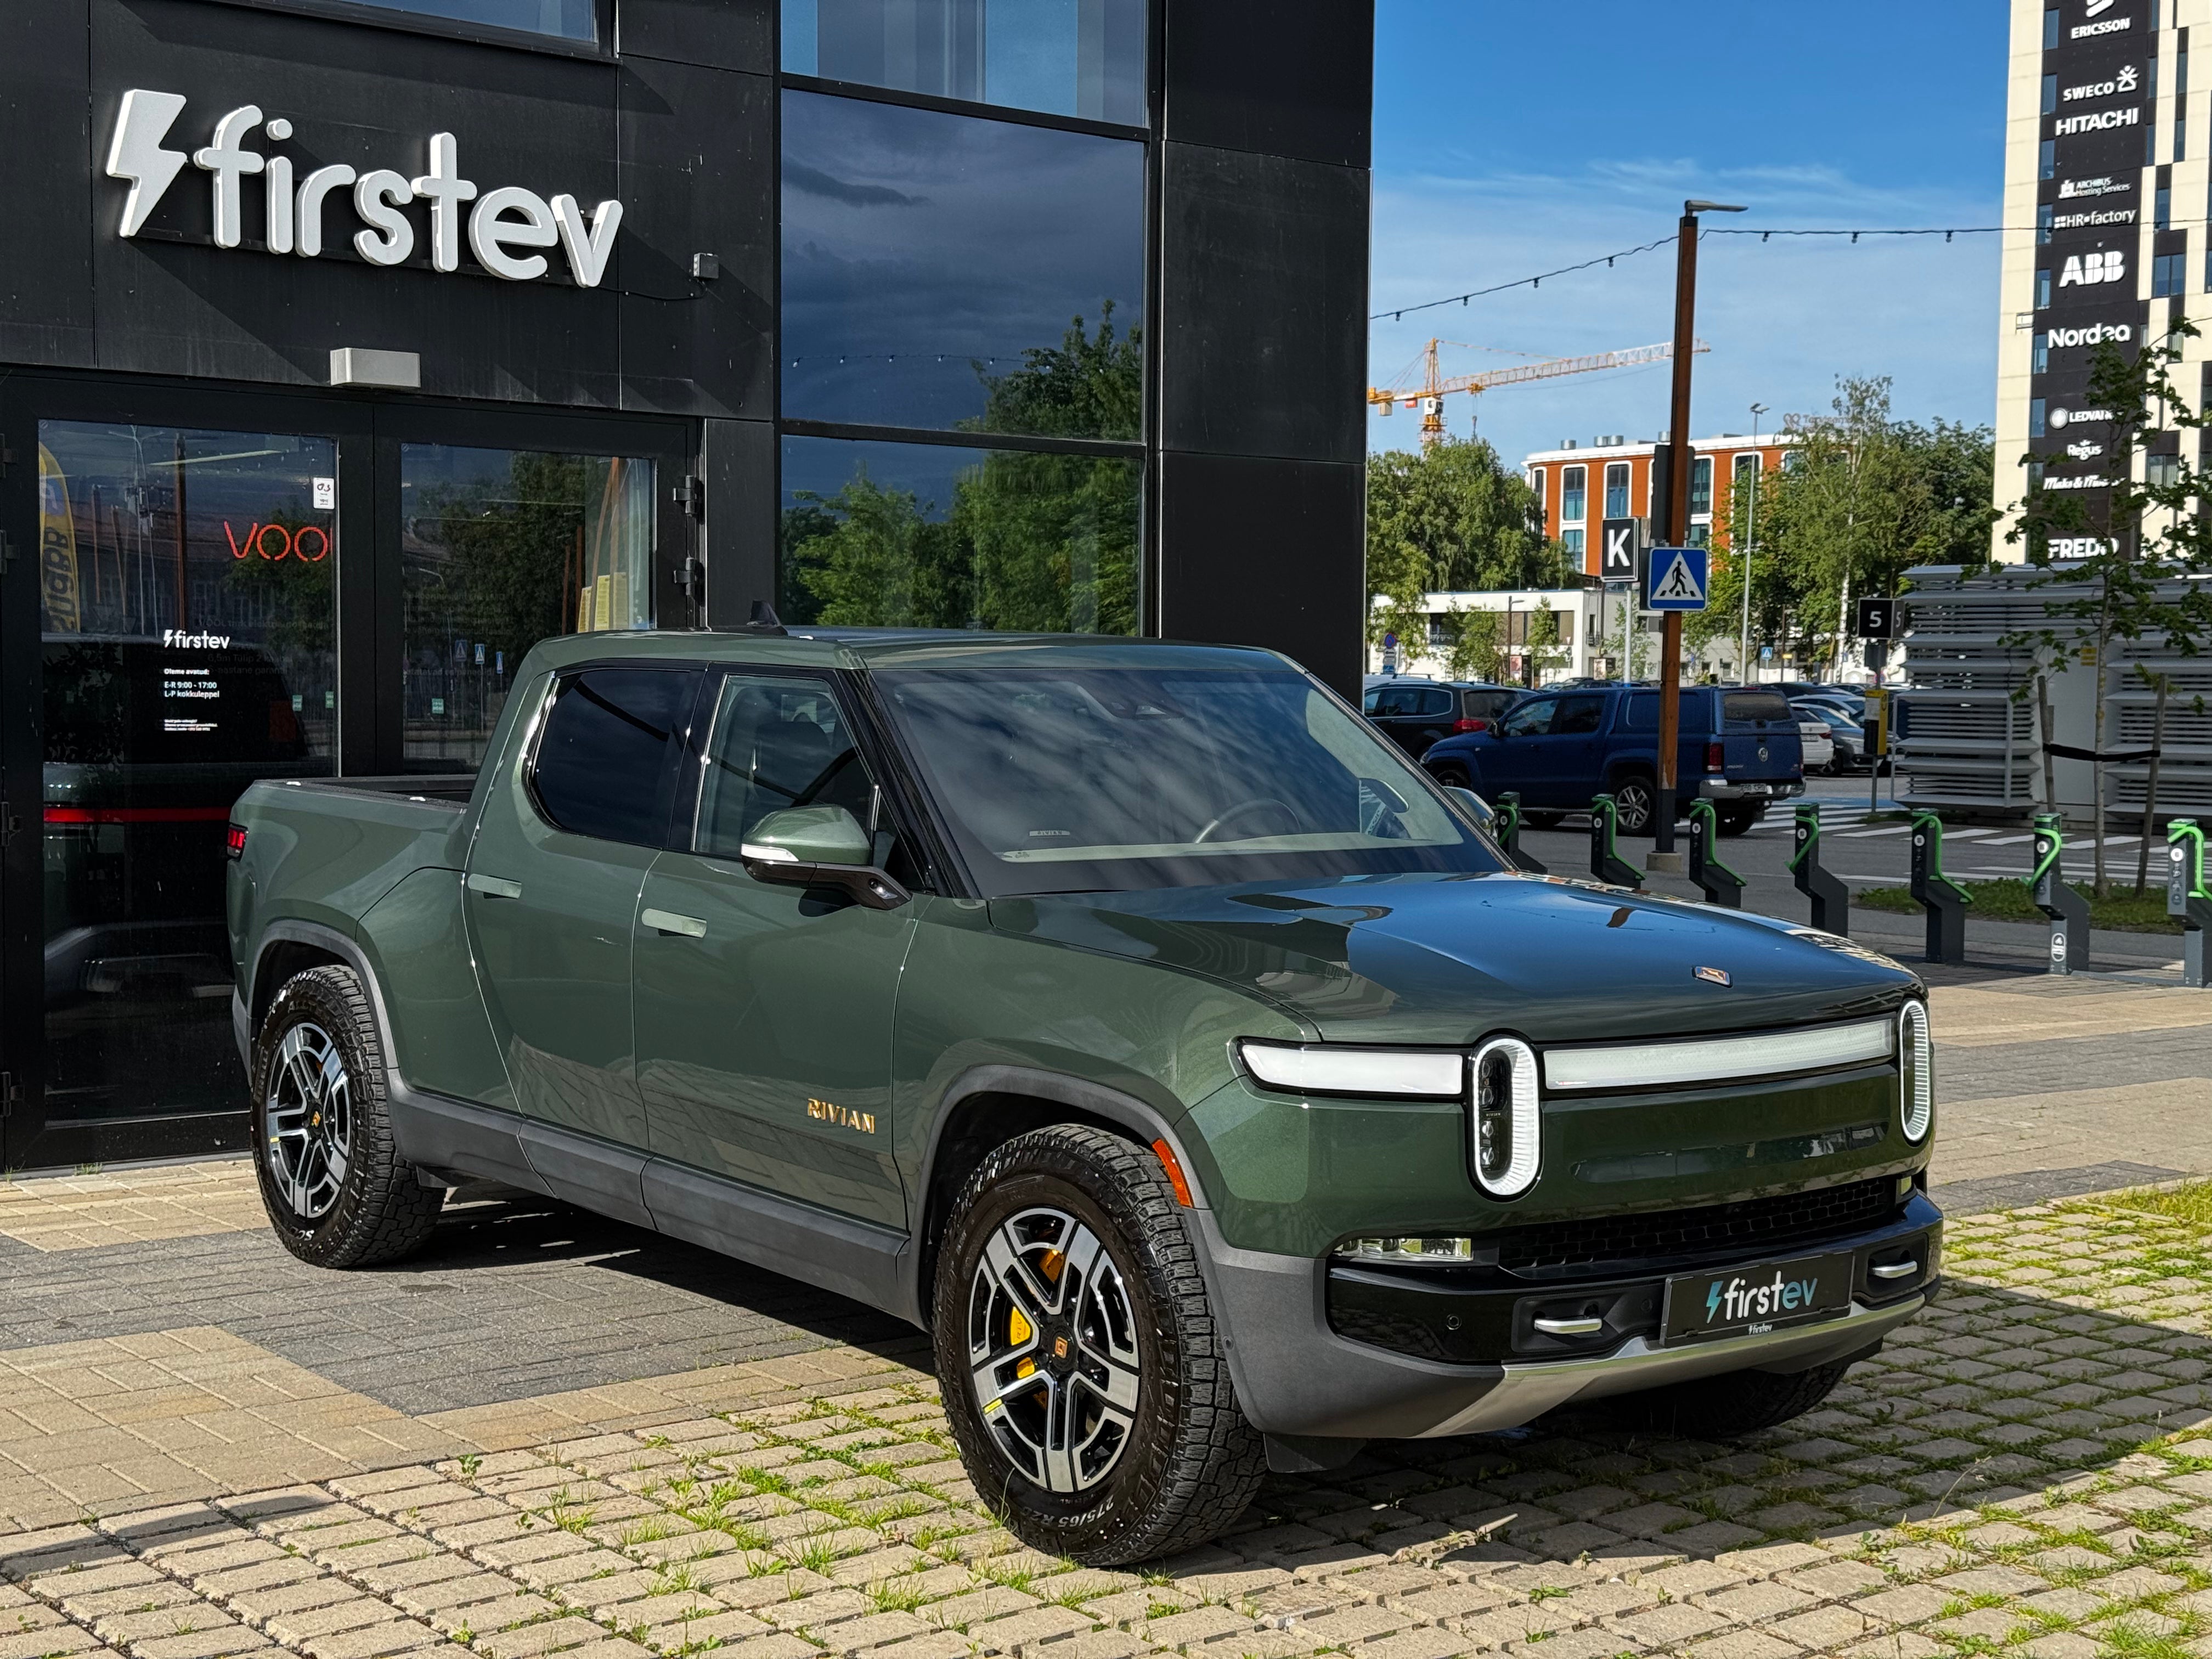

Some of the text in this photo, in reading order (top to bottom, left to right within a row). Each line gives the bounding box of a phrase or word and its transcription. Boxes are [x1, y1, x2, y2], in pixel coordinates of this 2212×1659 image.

[2070, 17, 2131, 40] ERICSSON
[2063, 82, 2115, 102] SWECO
[2055, 108, 2140, 136] HITACHI
[193, 104, 623, 288] firstev
[2102, 182, 2132, 194] Services
[2059, 251, 2125, 287] ABB
[2067, 443, 2103, 461] Regus
[1607, 528, 1631, 567] K
[1869, 611, 1882, 628] 5
[174, 629, 230, 649] firstev
[164, 690, 220, 699] L-P kokkuleppel
[177, 681, 193, 689] 9:00
[198, 681, 217, 689] 17:00
[807, 1098, 876, 1135] RIVIAN
[1724, 1270, 1818, 1321] firstev
[1752, 1323, 1773, 1334] firstev
[1057, 1494, 1115, 1528] 275/65
